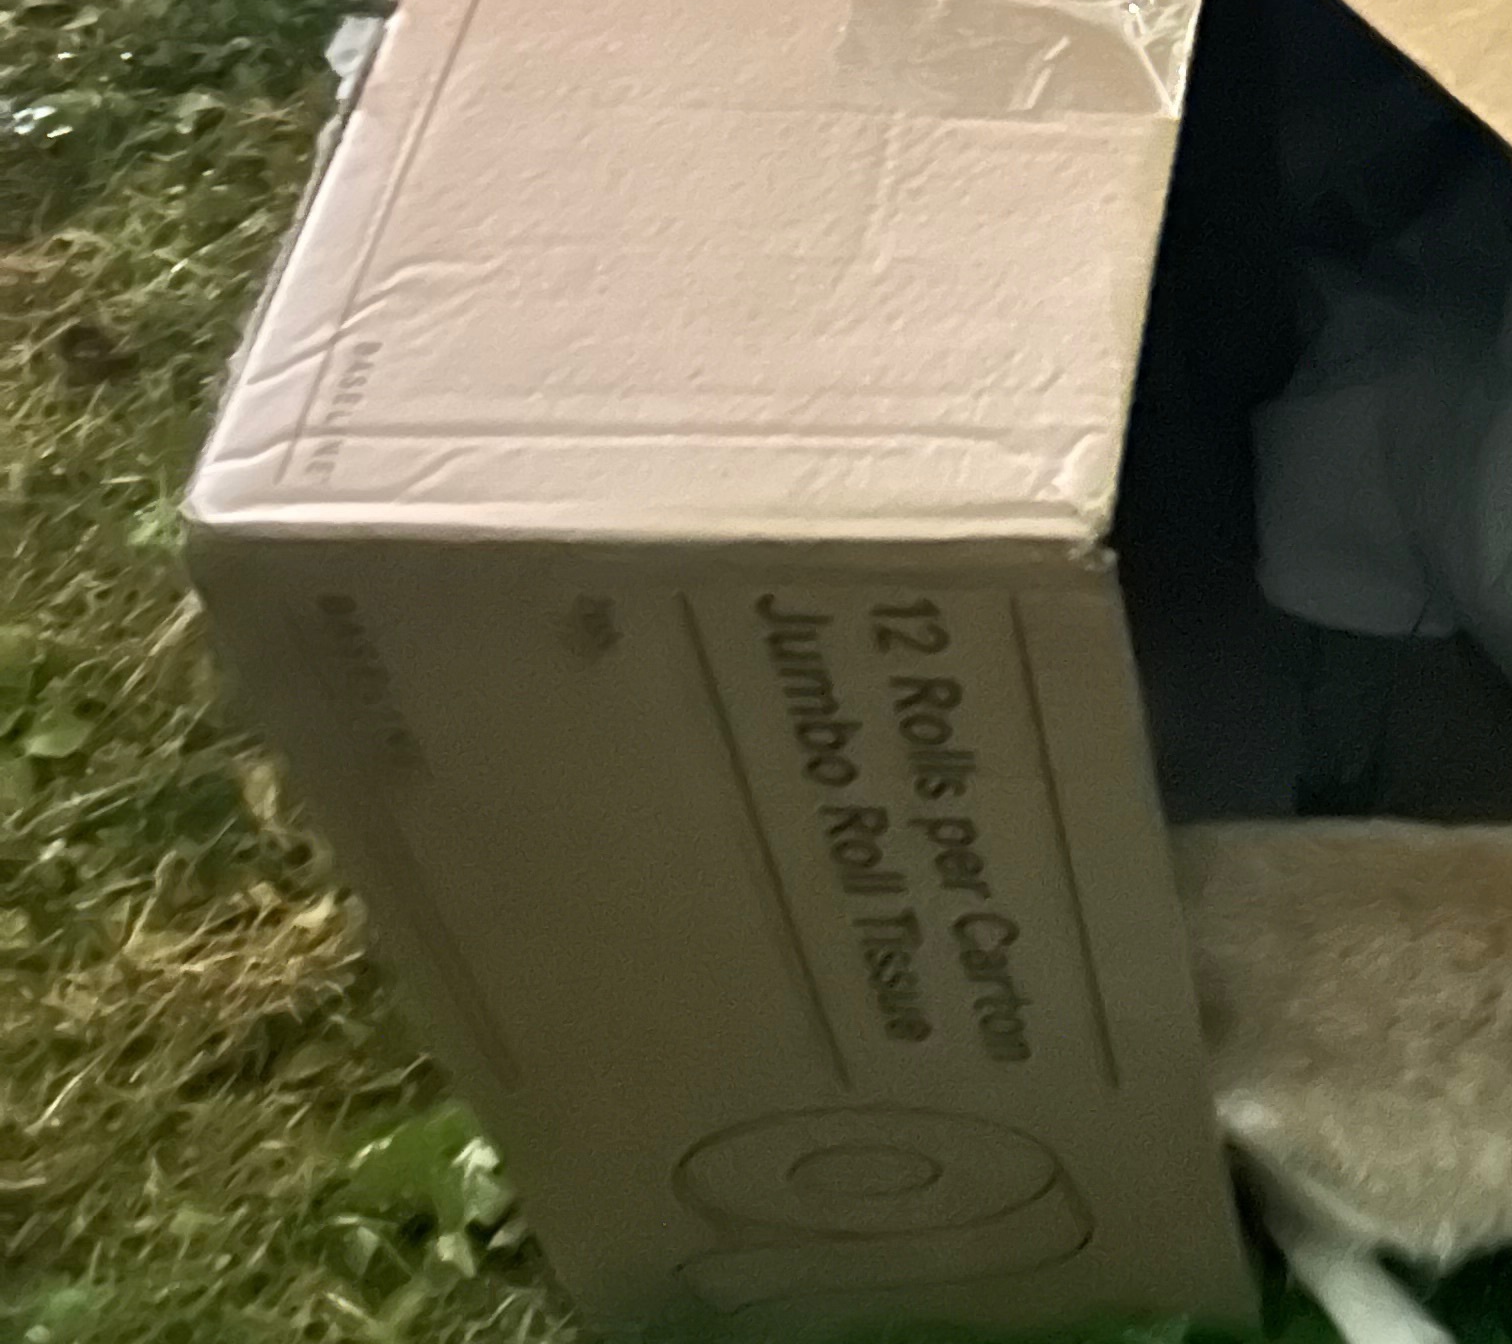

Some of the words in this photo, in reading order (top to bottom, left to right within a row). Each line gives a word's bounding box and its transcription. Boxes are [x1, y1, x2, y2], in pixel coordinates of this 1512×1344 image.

[755, 592, 864, 787] Jumbo
[868, 597, 951, 656] 12
[887, 674, 976, 803] Rolls
[819, 805, 906, 897] Roll
[908, 815, 992, 900] per
[852, 907, 934, 1045] Tissue
[951, 911, 1033, 1061] Carton
